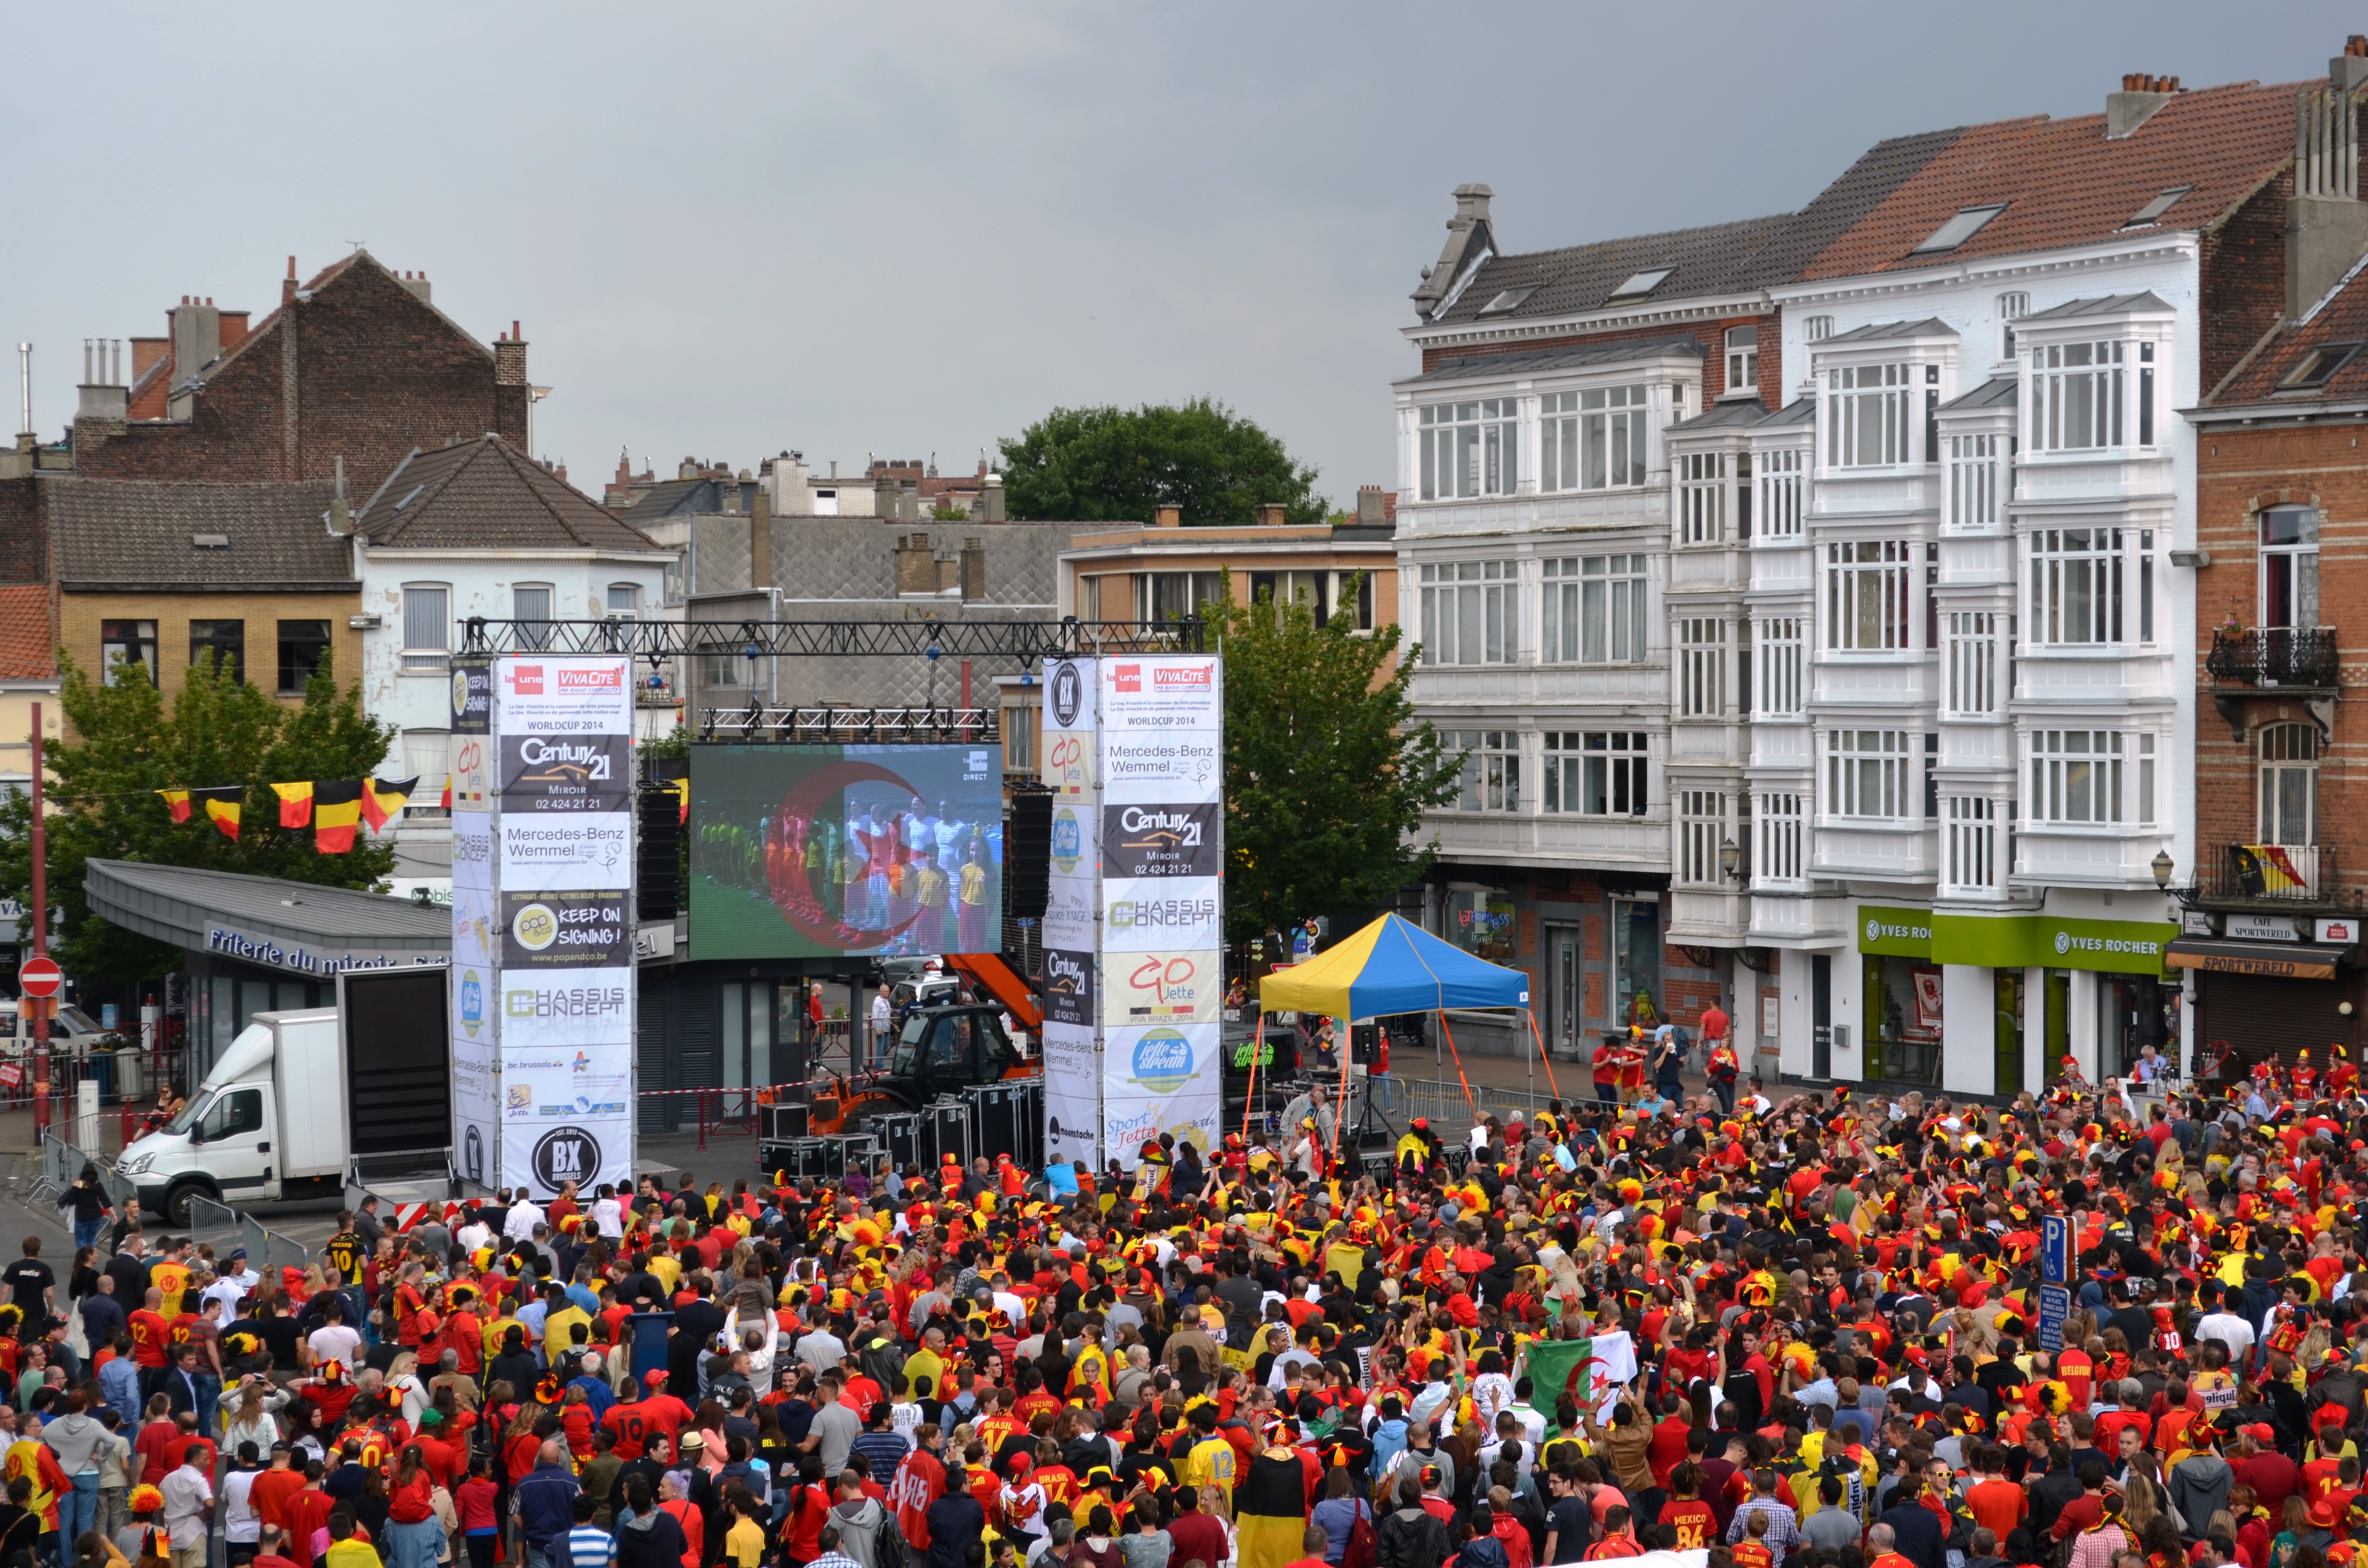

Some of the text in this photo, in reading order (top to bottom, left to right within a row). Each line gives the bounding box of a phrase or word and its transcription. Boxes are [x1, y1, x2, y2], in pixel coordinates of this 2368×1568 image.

[505, 675, 515, 683] la
[1060, 676, 1073, 706] BX
[528, 722, 580, 730] WORLDCUP
[1128, 717, 1195, 725] WORLDCUP 2014
[1110, 745, 1213, 757] Mercedes-Benz
[520, 738, 609, 780] Century 21
[1111, 760, 1170, 772] Wemmel
[1066, 767, 1080, 780] Jette
[536, 799, 600, 808] 02 424 21 21
[1122, 807, 1201, 846] Century 21
[508, 827, 624, 840] Mercedes-Benz
[509, 844, 574, 857] Wemmel
[1135, 864, 1192, 874] 02 424 21 21
[558, 907, 620, 923] KEEP ON
[520, 915, 548, 934] pop
[2254, 918, 2272, 927] CAFE
[558, 929, 620, 944] SIGNING !
[1881, 925, 1909, 937] YVES
[2235, 928, 2291, 939] SPORTWERELD
[1471, 932, 1492, 944] Travel
[209, 929, 396, 973] Friterie du miroir
[2071, 937, 2158, 955] YVES ROCHER
[532, 953, 607, 963] www.popandco.be
[2203, 956, 2295, 976] SPORTWERELD
[1048, 952, 1085, 995] Century 21
[1163, 986, 1194, 1000] Jette
[1055, 1010, 1081, 1022] 02 424 21 21
[1044, 1038, 1092, 1054] Mercedes-Benz
[1139, 1041, 1170, 1060] jette
[454, 1056, 489, 1075] Mercedes-Benz
[1046, 1052, 1072, 1066] Wemmel
[1139, 1056, 1186, 1069] stream
[454, 1072, 475, 1087] Wemmel
[509, 1109, 529, 1117] Jette
[1107, 1111, 1152, 1135] Sport
[1189, 1117, 1216, 1130] Jette
[1061, 1127, 1094, 1140] moonstache
[553, 1140, 581, 1172] BX
[552, 1172, 581, 1181] BRUSSELS
[2047, 1221, 2059, 1252] P
[333, 1250, 351, 1272] 10
[131, 1322, 148, 1344] 12
[173, 1327, 190, 1344] 12
[2164, 1332, 2180, 1350] 10
[1025, 1400, 1054, 1409] E.HAZARD
[617, 1418, 642, 1443] 10
[984, 1421, 1012, 1431] BRASIL
[1212, 1450, 1233, 1480] 12
[1038, 1473, 1069, 1484] BRASIL
[1674, 1514, 1706, 1526] MEXICO
[1677, 1525, 1704, 1550] 86
[1736, 1553, 1766, 1566] DE BRUYNE
